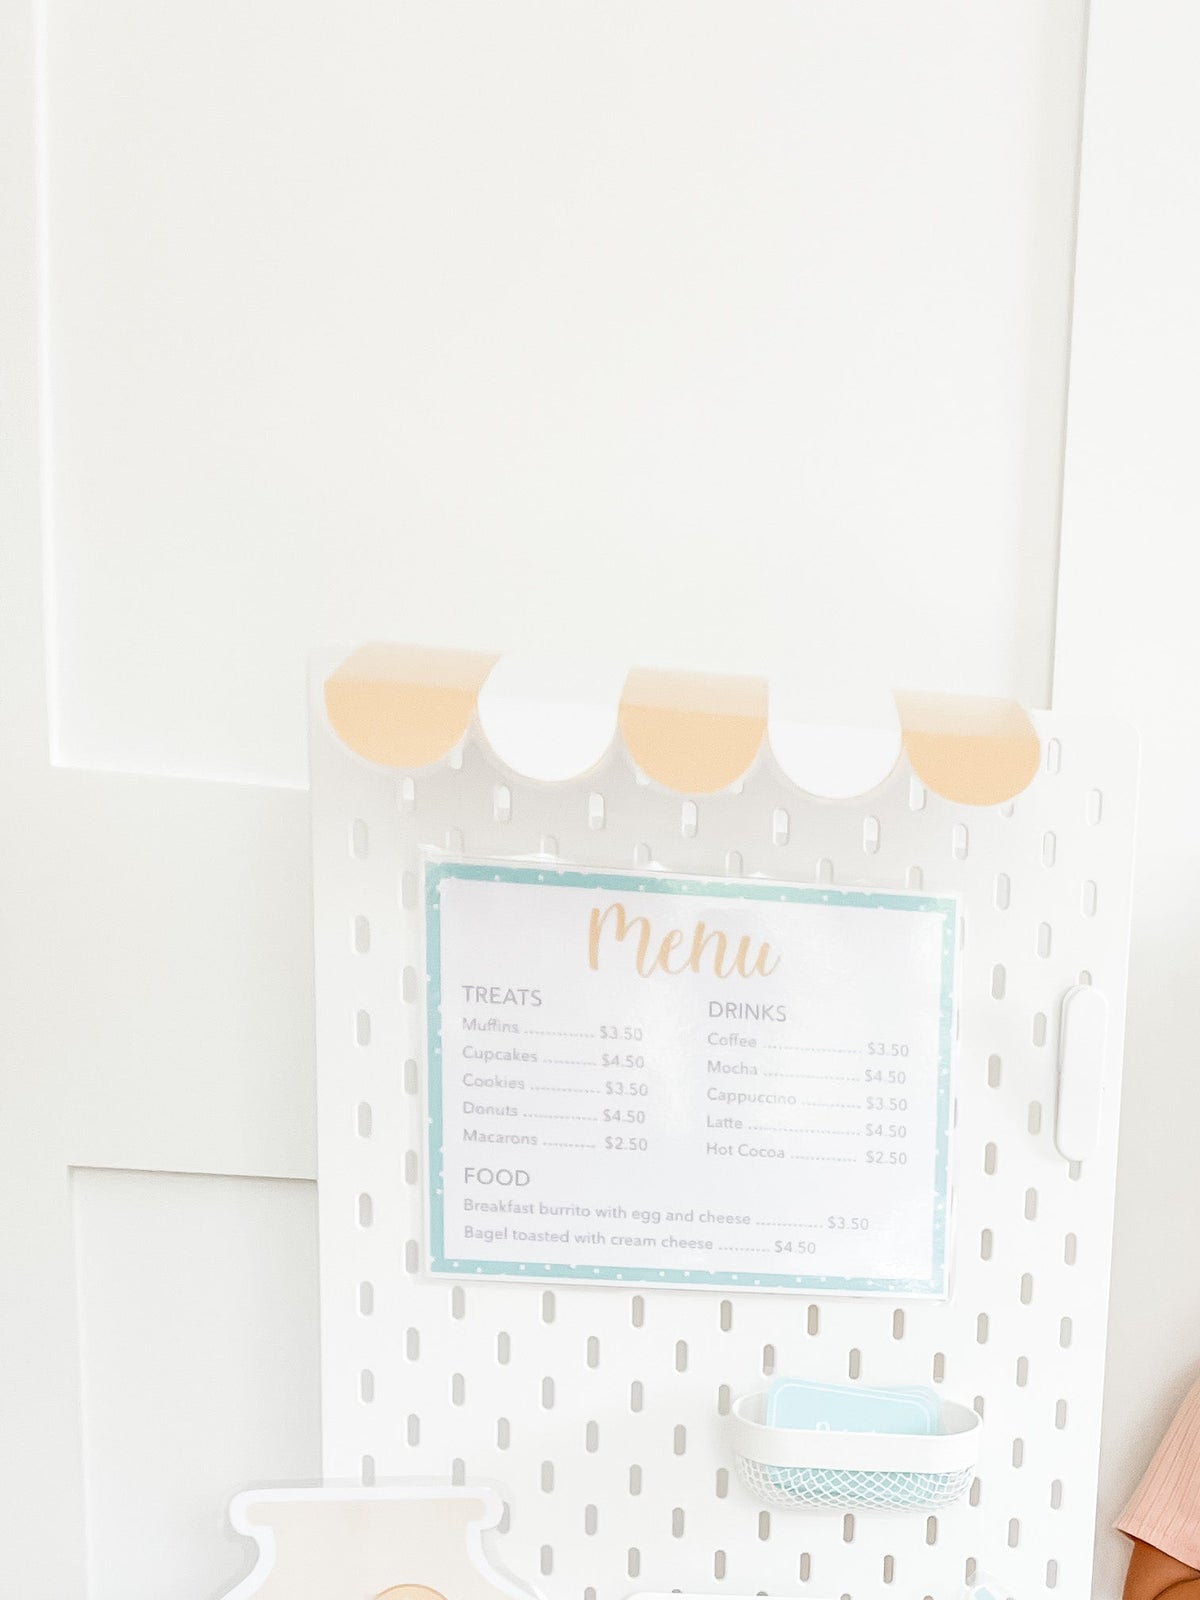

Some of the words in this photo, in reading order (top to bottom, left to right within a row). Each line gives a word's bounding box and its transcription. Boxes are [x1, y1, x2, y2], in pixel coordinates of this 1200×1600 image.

[588, 902, 781, 979] Menu
[462, 985, 543, 1007] TREATS
[708, 1001, 787, 1022] DRINKS
[463, 1017, 520, 1034] Muffins
[599, 1025, 643, 1041] $3.50
[707, 1032, 757, 1048] Coffee
[867, 1042, 909, 1057] $3.50
[462, 1045, 538, 1063] Cupcakes
[602, 1053, 645, 1068] $4.50
[707, 1060, 758, 1075] Mocha
[864, 1069, 906, 1084] $4.50
[462, 1073, 525, 1089] Cookies
[605, 1081, 648, 1096] $3.50
[707, 1087, 797, 1105] Cappuccino
[866, 1096, 908, 1111] $3.50
[463, 1101, 518, 1117] Donuts
[603, 1109, 646, 1124] $4.50
[706, 1115, 743, 1129] Latte
[865, 1123, 907, 1138] $4.50
[463, 1129, 538, 1146] Macarons
[605, 1136, 648, 1151] $2.50
[706, 1142, 733, 1156] Hot
[738, 1144, 785, 1159] Cocoa
[865, 1150, 907, 1165] $2.50
[464, 1168, 530, 1187] FOOD
[464, 1199, 535, 1215] Breakfast
[539, 1202, 591, 1218] burrito
[595, 1205, 628, 1220] with
[631, 1211, 661, 1225] egg
[665, 1209, 694, 1223] and
[699, 1210, 752, 1226] cheese
[827, 1216, 870, 1231] $3.50
[464, 1226, 508, 1242] Bagel
[512, 1229, 570, 1244] toasted
[574, 1231, 606, 1245] with
[611, 1236, 657, 1248] cream
[661, 1235, 714, 1251] cheese
[774, 1240, 817, 1255] $4.50
